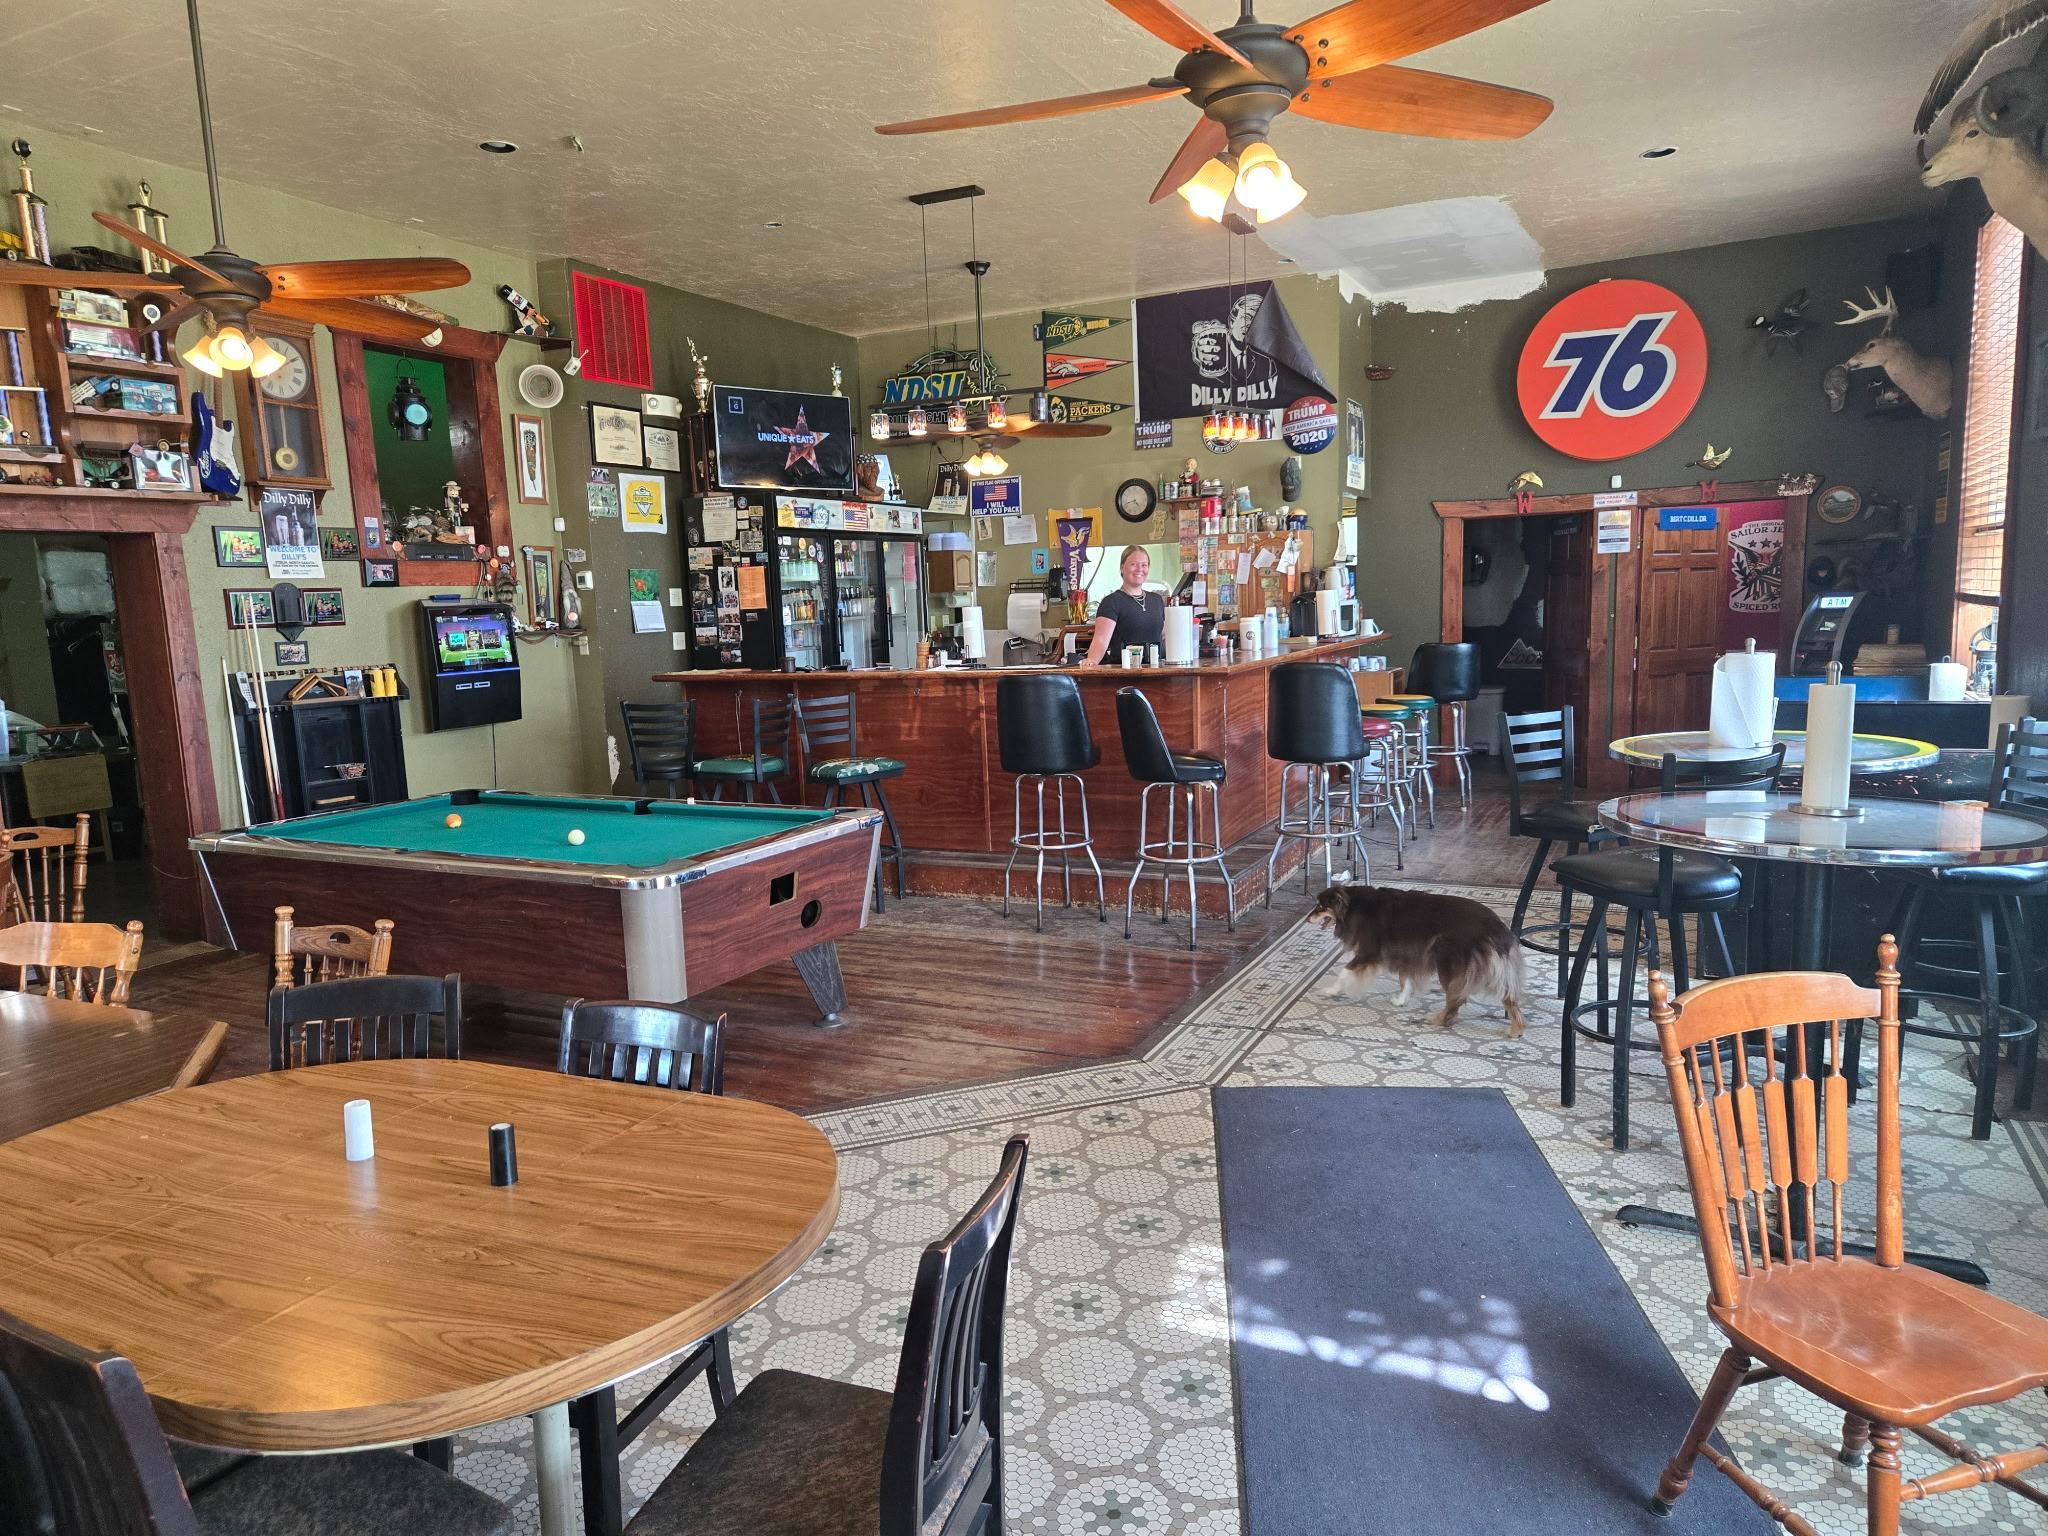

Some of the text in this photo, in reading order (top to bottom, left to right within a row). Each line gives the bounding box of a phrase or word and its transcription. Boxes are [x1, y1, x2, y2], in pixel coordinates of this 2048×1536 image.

[1046, 323, 1075, 337] NDSU
[1537, 310, 1678, 420] 76
[883, 371, 967, 404] NDSU
[1191, 376, 1278, 407] DILLY DILLY
[1070, 404, 1111, 416] PACKERS
[1287, 404, 1327, 421] TRUMP
[1136, 423, 1171, 436] TRUMP
[1297, 420, 1319, 429] AMERICA
[757, 432, 814, 444] UNIQUE EATS
[1291, 429, 1328, 446] 2020
[262, 491, 312, 509] Dilly Dilly
[1516, 491, 1535, 514] W
[1730, 526, 1769, 540] SAILOR
[1069, 549, 1081, 590] VIKINGS
[1731, 601, 1780, 611] SPICED R
[1827, 598, 1847, 606] ATM
